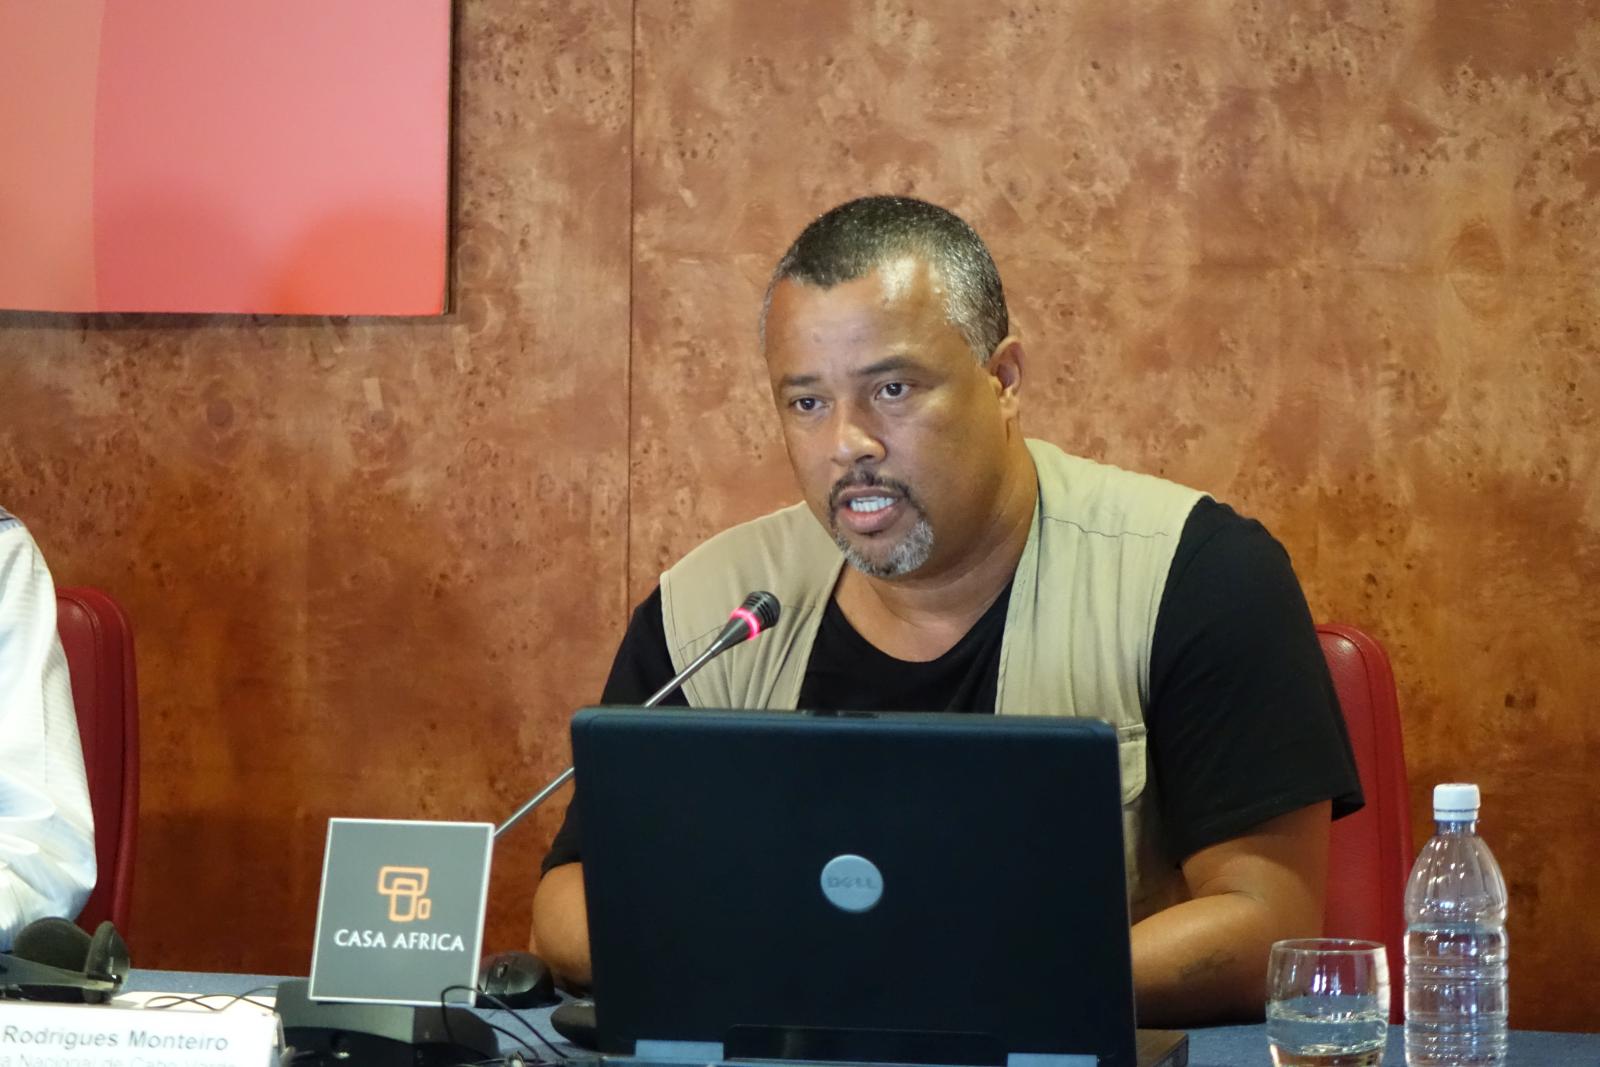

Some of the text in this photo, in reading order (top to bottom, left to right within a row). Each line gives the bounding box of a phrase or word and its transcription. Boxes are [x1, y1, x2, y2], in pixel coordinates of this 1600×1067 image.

[827, 876, 879, 889] DELL
[334, 928, 465, 952] CASA AFRICA
[2, 1025, 229, 1051] Rodrigues Monteiro
